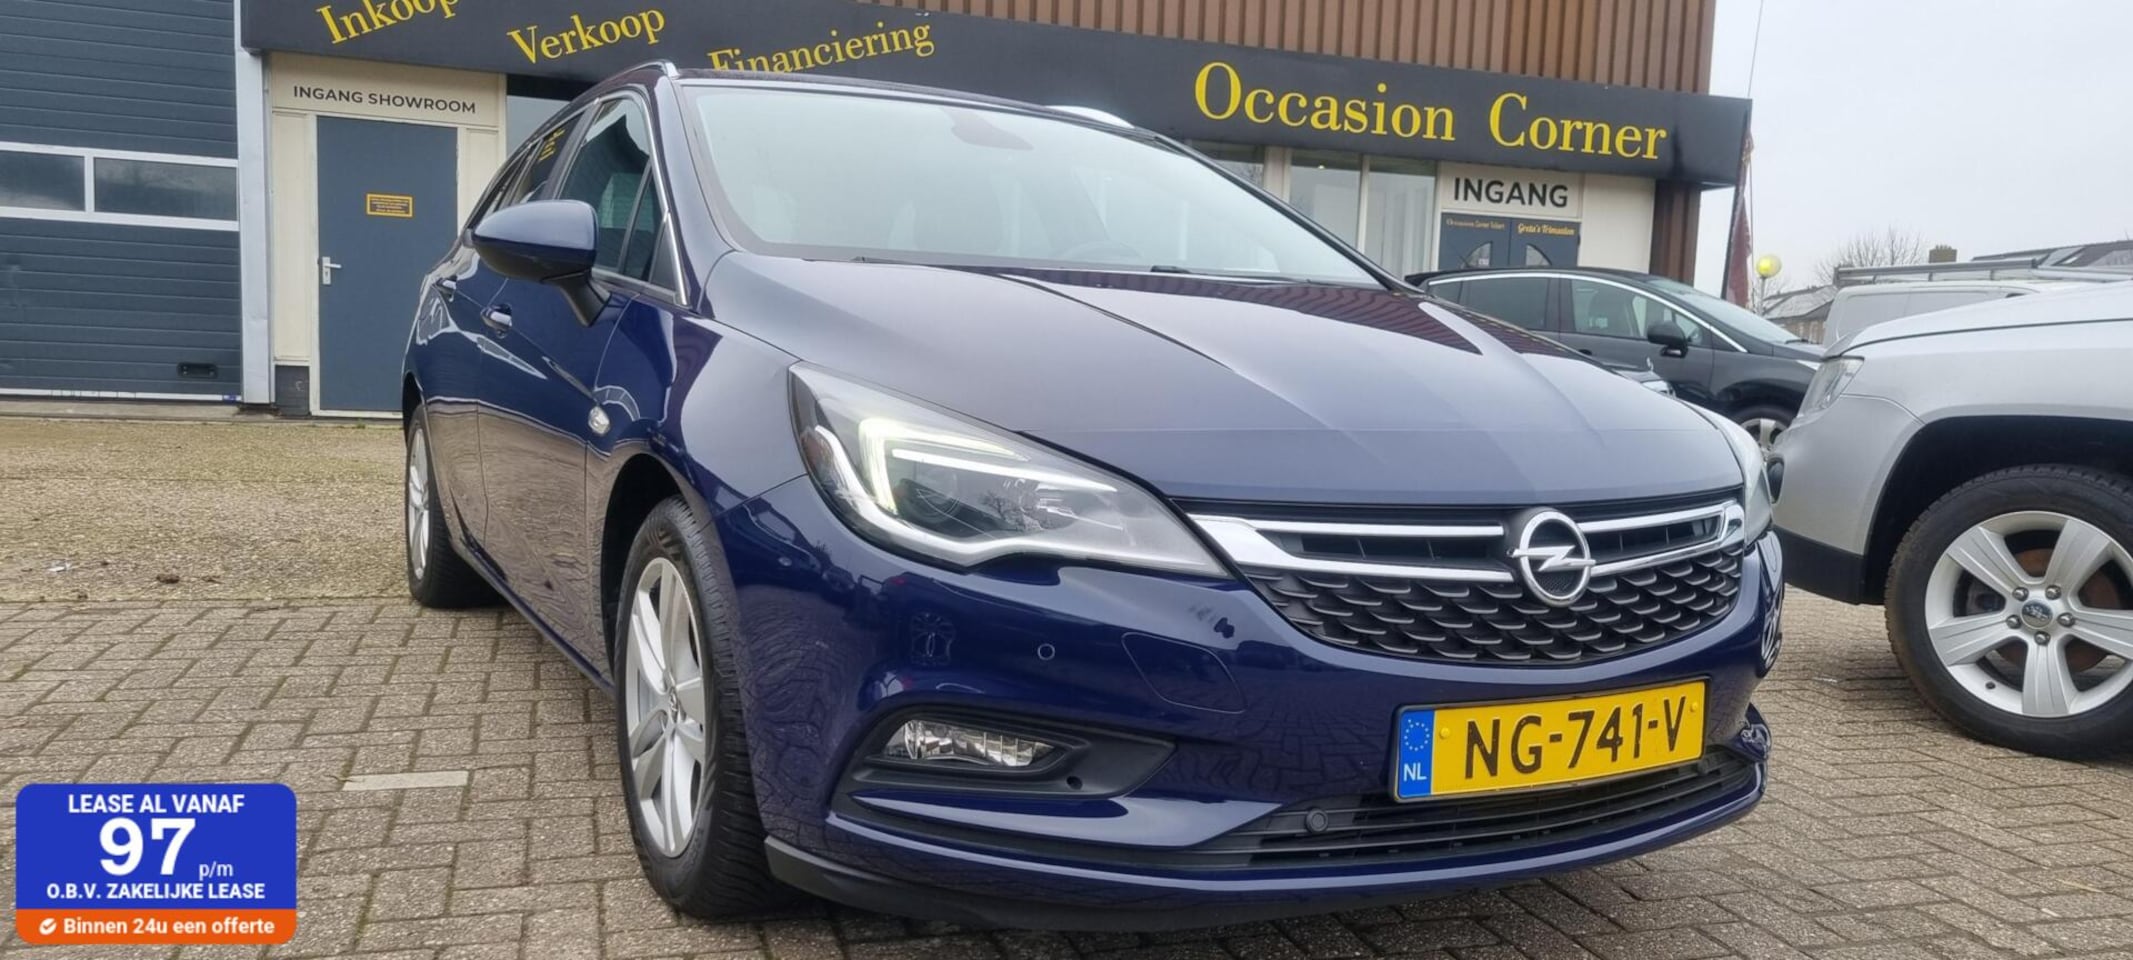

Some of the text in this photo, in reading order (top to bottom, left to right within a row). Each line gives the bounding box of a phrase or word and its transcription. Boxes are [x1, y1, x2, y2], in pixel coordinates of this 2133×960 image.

[507, 8, 665, 64] Verkoop
[707, 21, 935, 72] Financiering
[293, 85, 476, 114] INGANG SHOWROOM
[1194, 61, 1667, 160] Occasion Corner
[1454, 177, 1568, 208] INGANG
[1464, 696, 1686, 780] NG-741-V
[1403, 762, 1427, 781] NL
